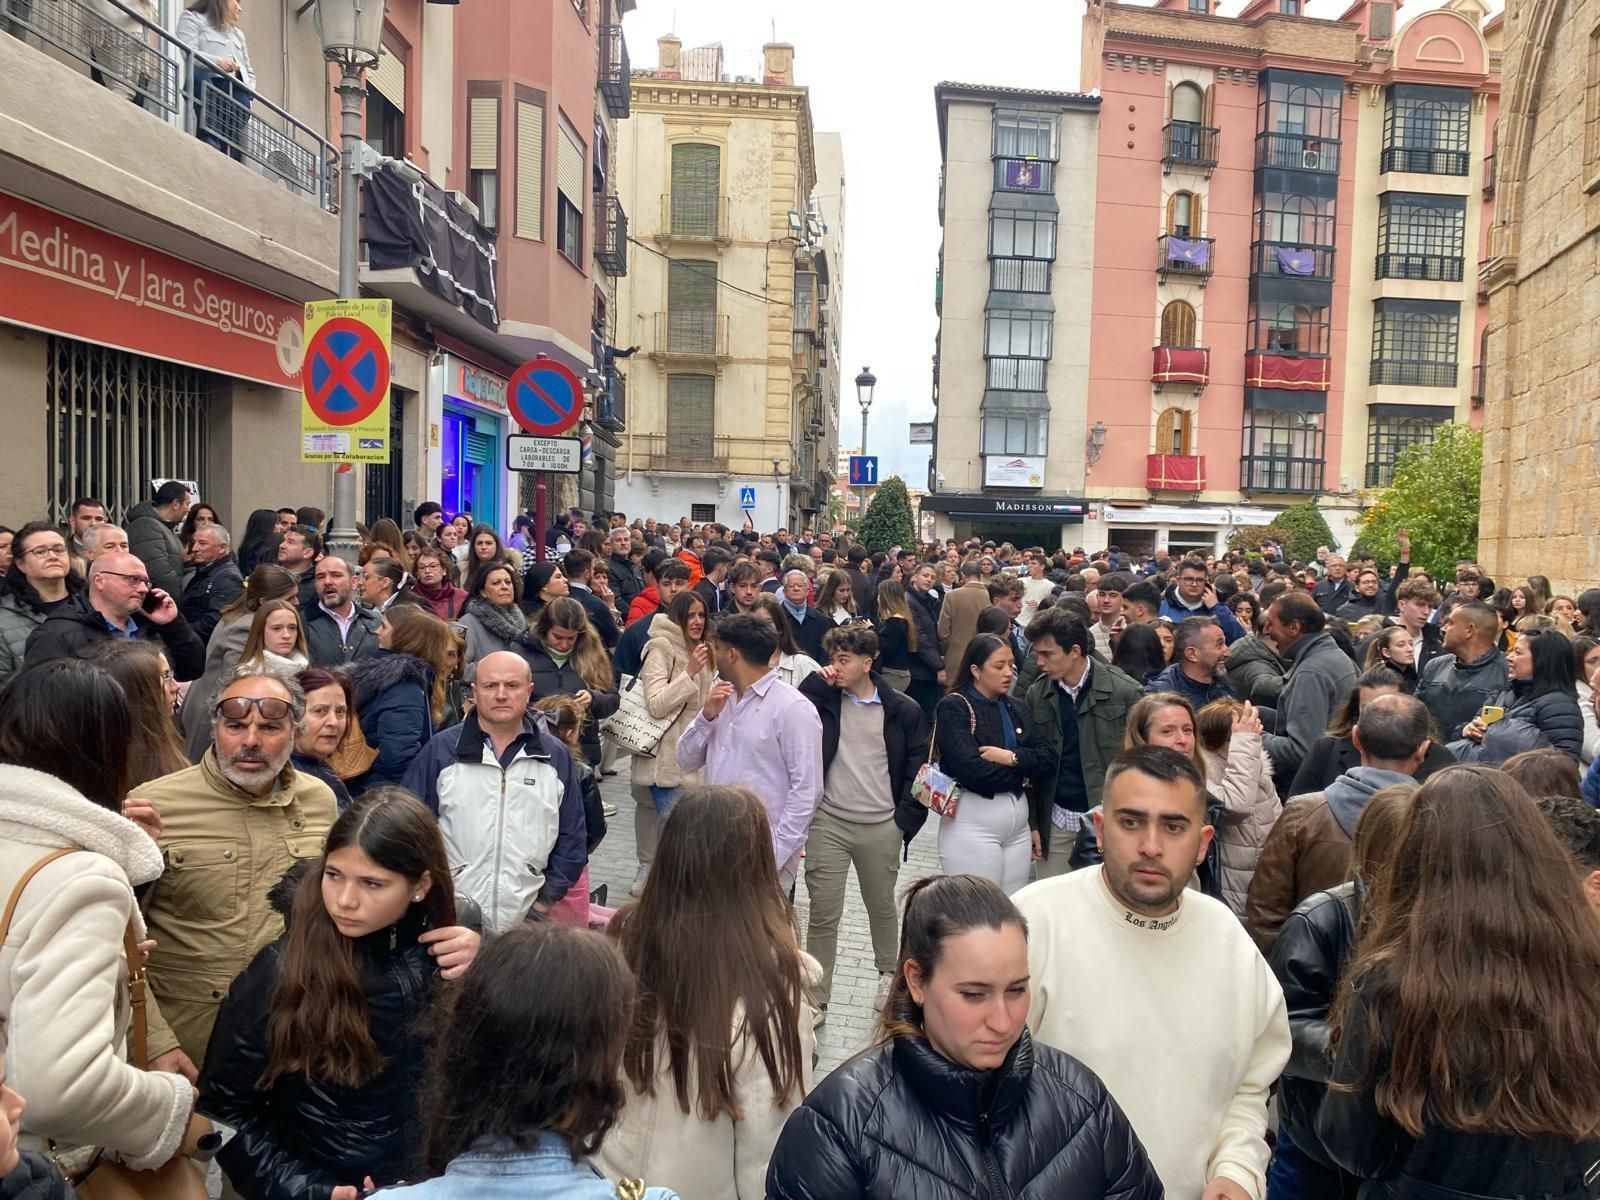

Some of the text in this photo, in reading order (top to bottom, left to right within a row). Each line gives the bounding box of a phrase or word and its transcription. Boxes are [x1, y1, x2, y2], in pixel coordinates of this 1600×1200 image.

[114, 261, 130, 299] y
[136, 257, 186, 309] Jara
[193, 278, 275, 336] Seguros
[521, 454, 556, 462] LABORABLES
[1124, 911, 1145, 928] Los
